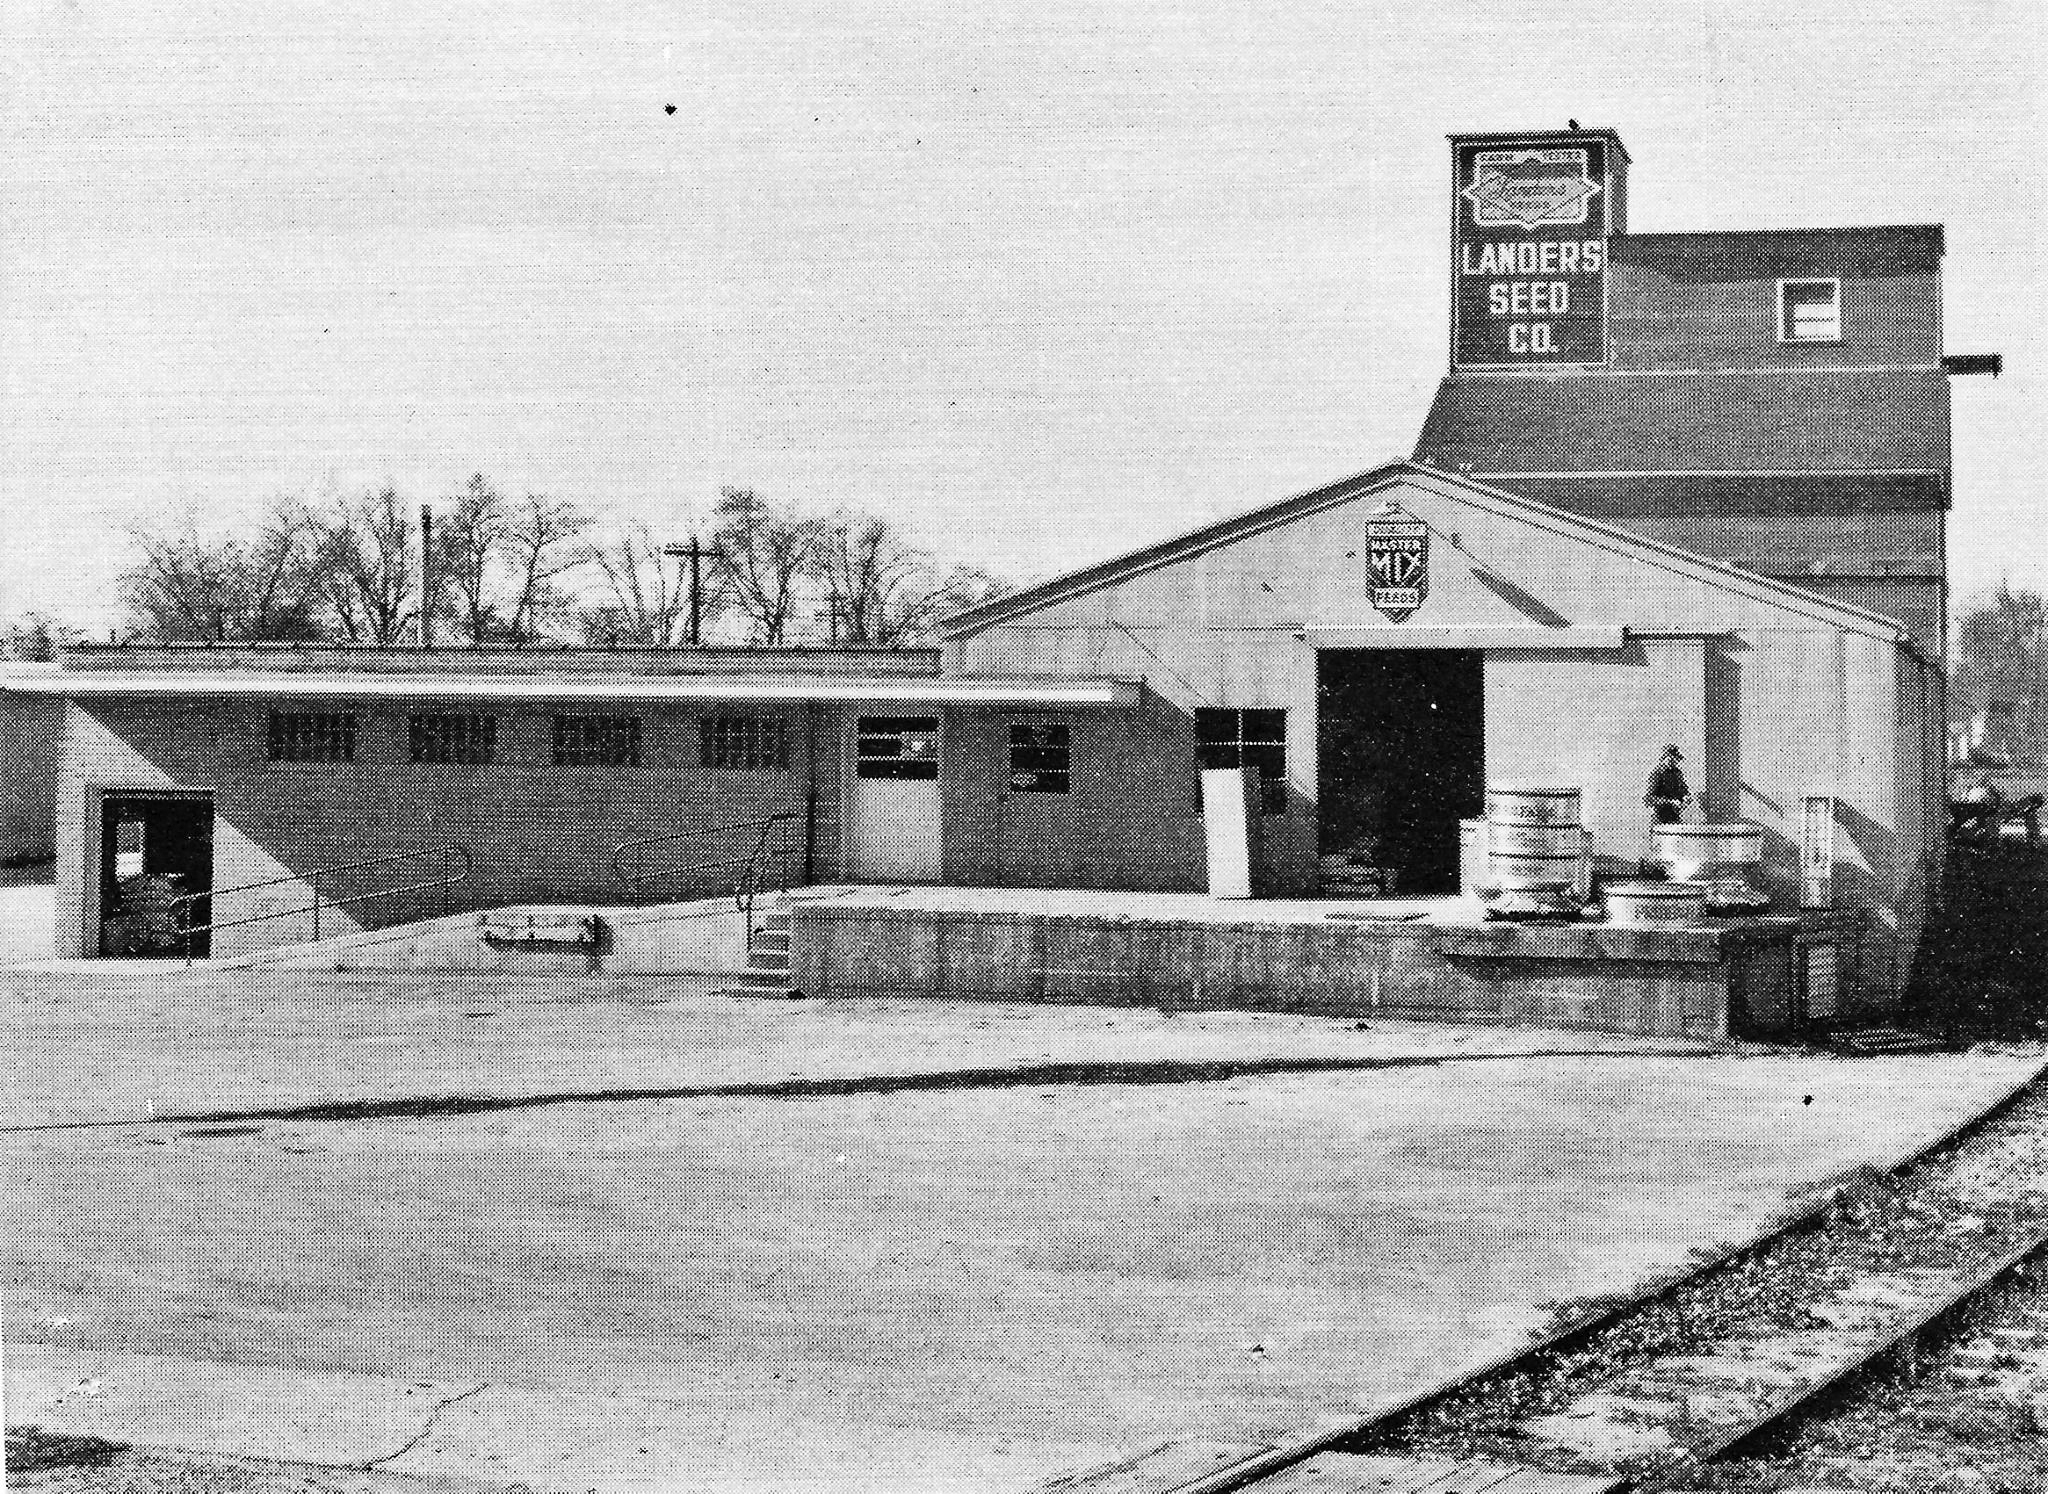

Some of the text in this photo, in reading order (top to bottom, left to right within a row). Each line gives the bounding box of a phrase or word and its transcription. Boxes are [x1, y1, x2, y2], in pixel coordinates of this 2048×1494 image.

[1461, 239, 1603, 275] LANDERS
[1489, 280, 1570, 315] SEED
[1508, 322, 1560, 353] CO.
[1371, 539, 1421, 551] MASTER
[1371, 551, 1421, 583] MIX
[1375, 591, 1418, 604] FEEDS
